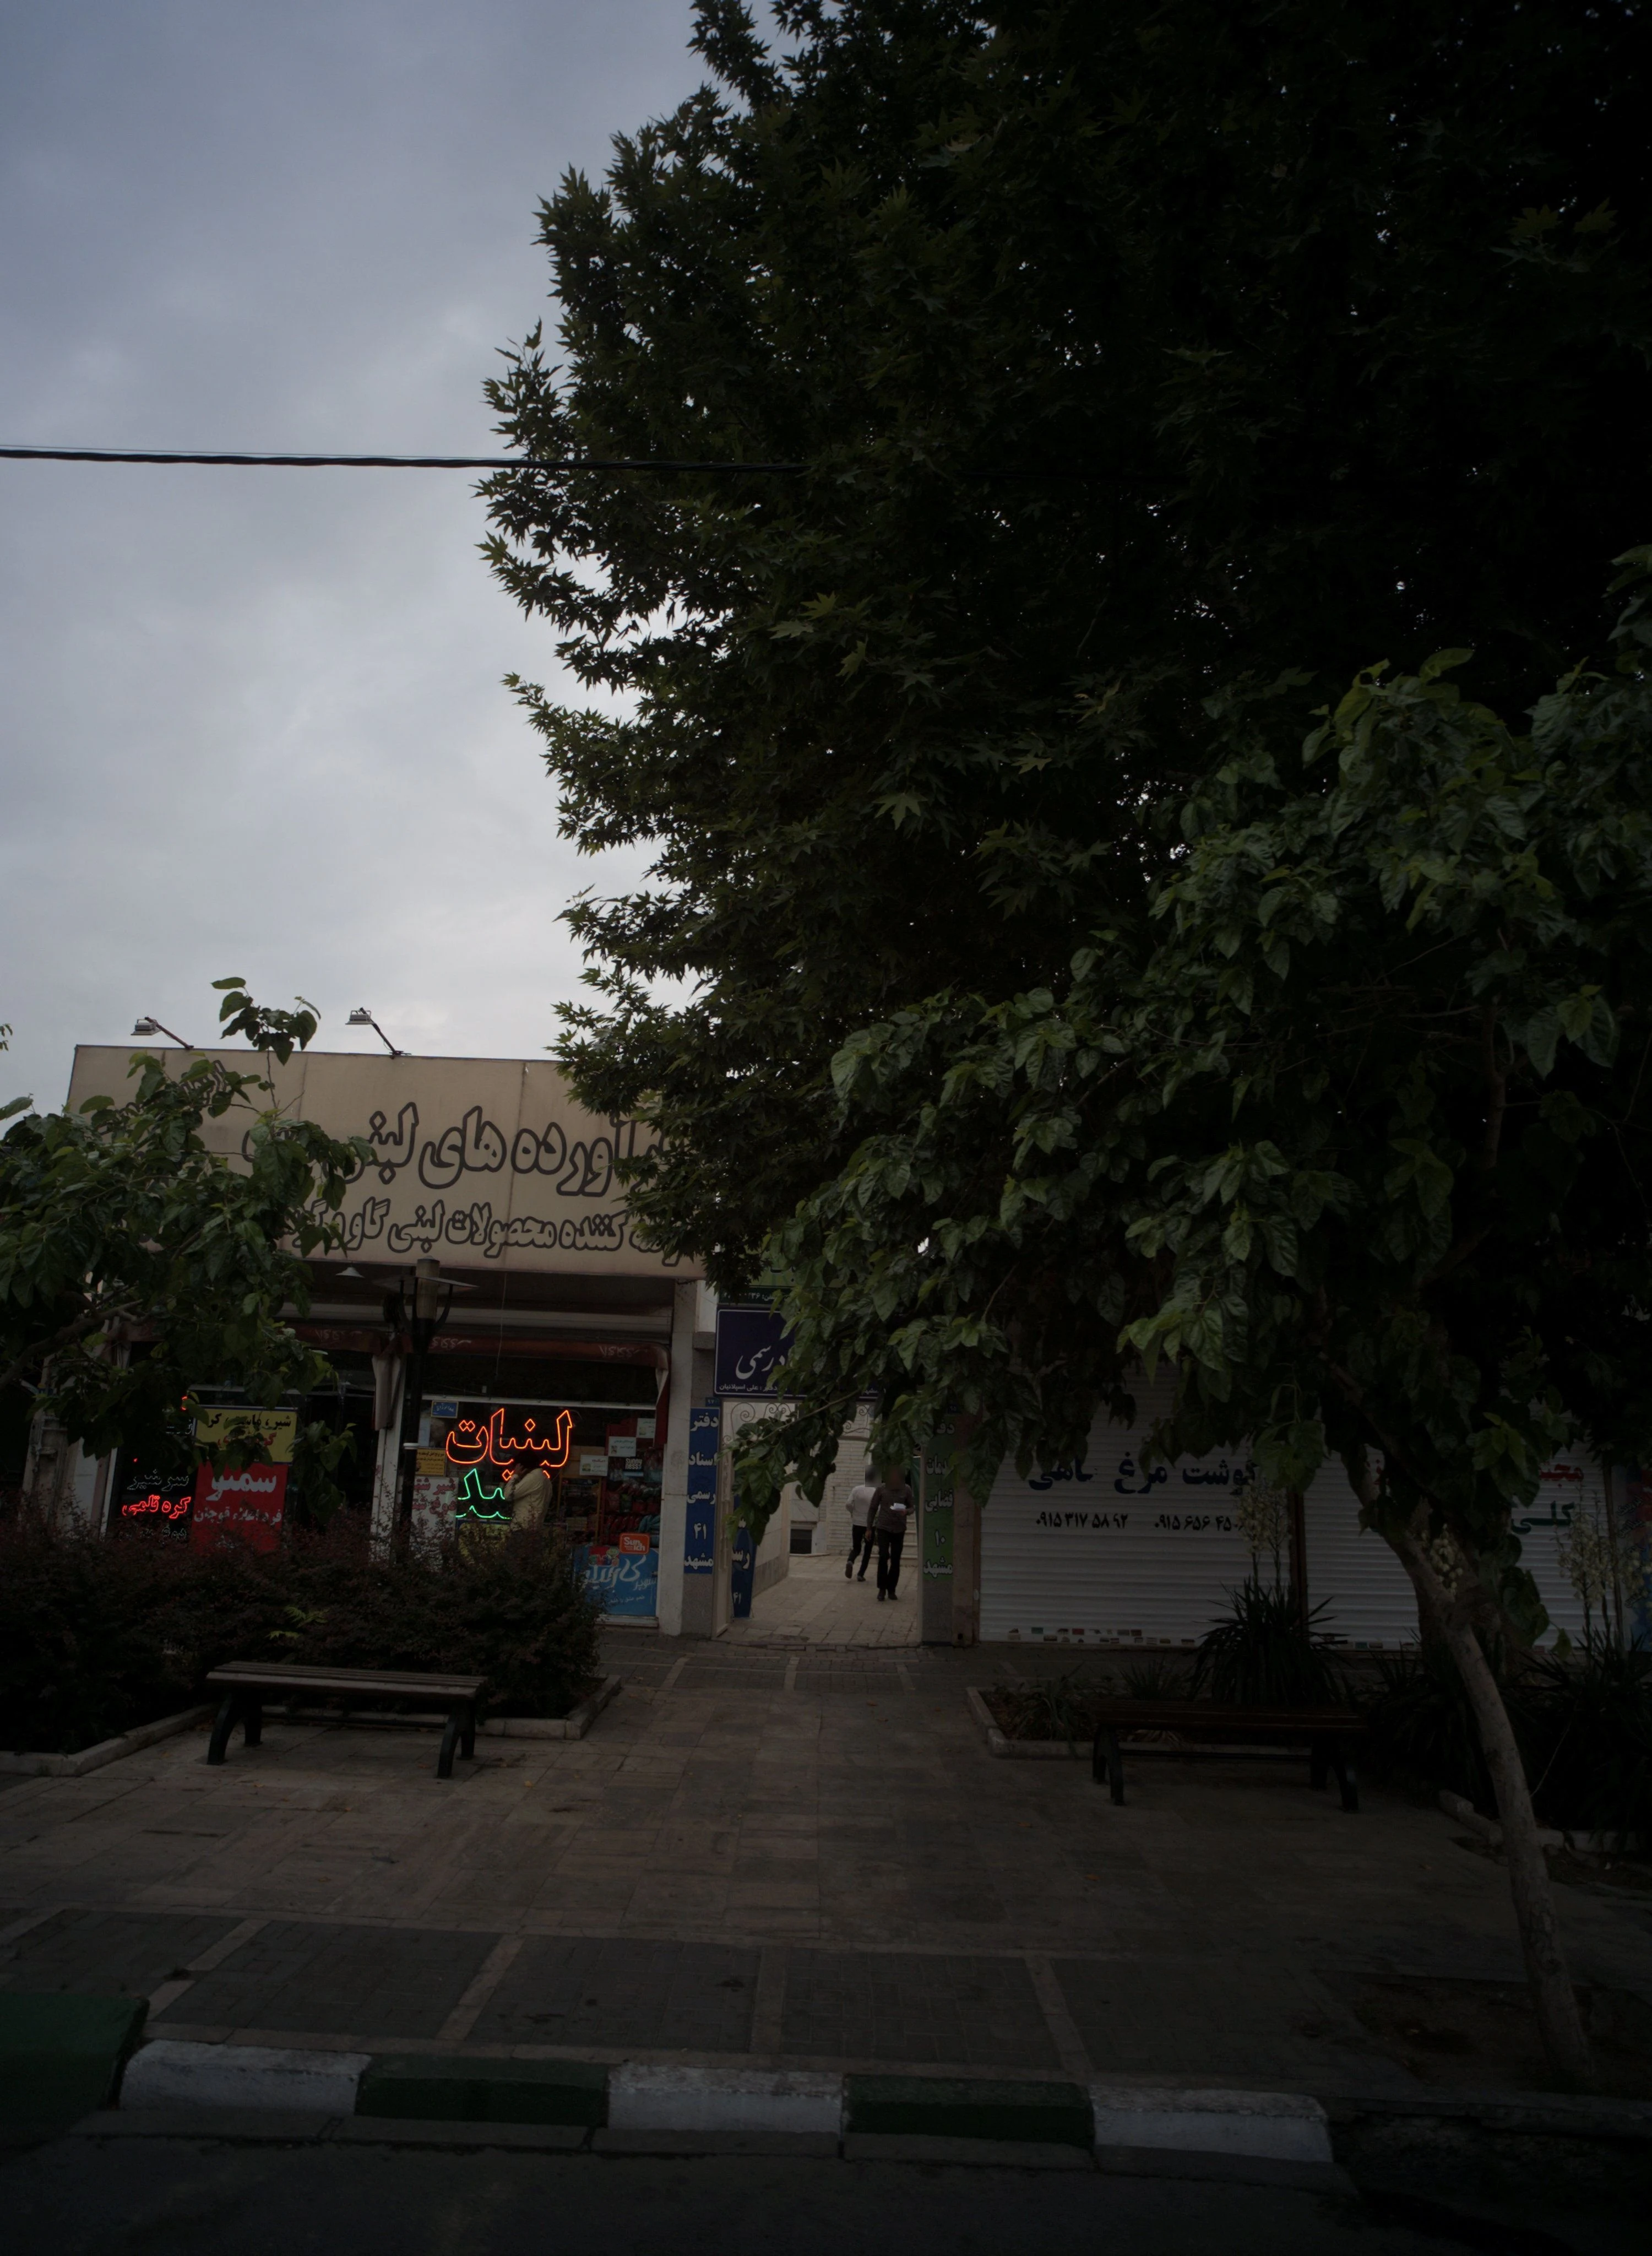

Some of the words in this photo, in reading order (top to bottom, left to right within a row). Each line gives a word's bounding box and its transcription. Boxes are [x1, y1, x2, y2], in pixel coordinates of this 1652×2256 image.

[419, 1105, 507, 1189] های
[344, 1196, 391, 1251] گاو
[387, 1199, 445, 1253] لبنی
[445, 1202, 557, 1257] محصولات
[558, 1210, 631, 1252] کننده
[207, 1407, 222, 1428] کر
[691, 1412, 719, 1431] دفتر
[445, 1407, 573, 1482] لبنیات
[688, 1451, 718, 1467] اسناد
[1114, 1451, 1167, 1494] مرغ
[161, 1495, 192, 1520] کره
[687, 1488, 716, 1505] رسمی
[693, 1522, 707, 1541] ۴۱
[684, 1552, 714, 1570] مشهد
[923, 1556, 953, 1578] مشهد
